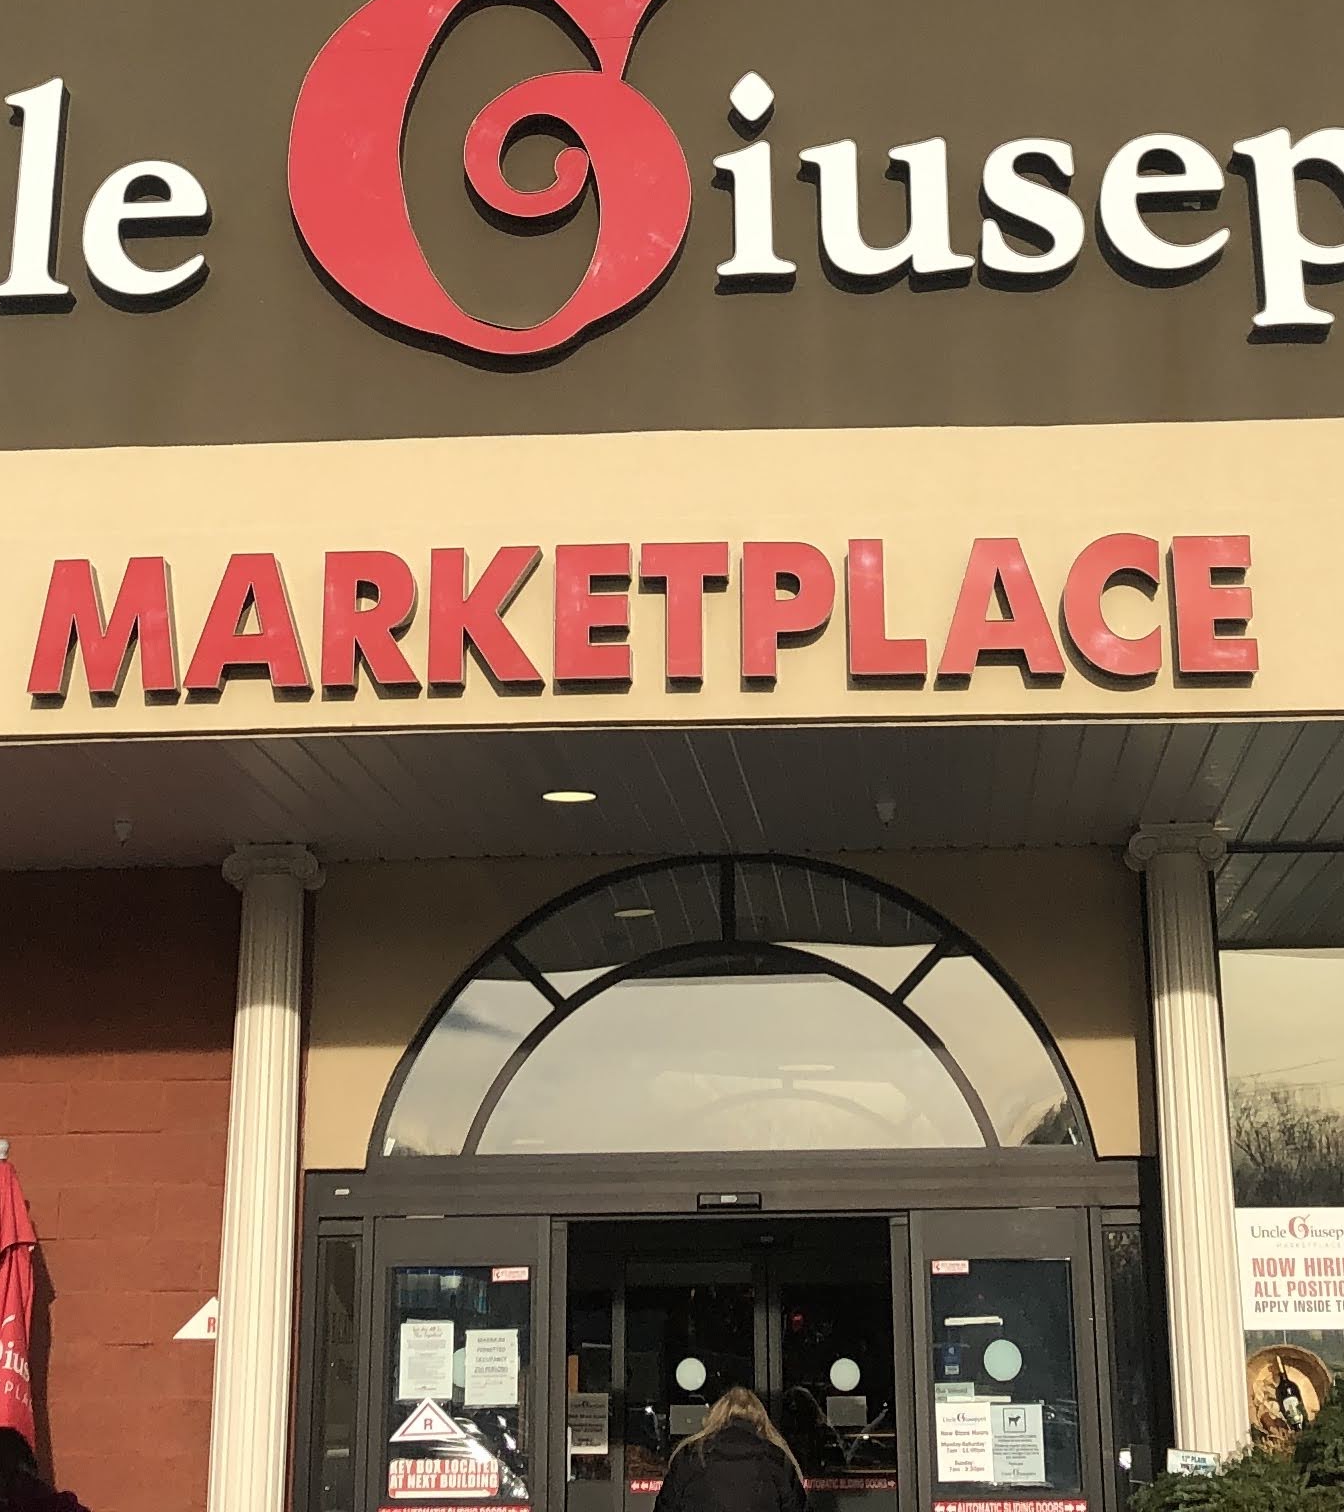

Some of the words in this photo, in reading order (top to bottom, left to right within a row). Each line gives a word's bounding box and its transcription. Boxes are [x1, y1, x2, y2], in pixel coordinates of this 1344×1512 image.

[27, 531, 1260, 696] MARKETPLACE
[1250, 1225, 1287, 1239] Uncle
[1252, 1257, 1296, 1278] NOW
[1254, 1280, 1281, 1298] ALL
[1254, 1300, 1289, 1313] APPLY
[1293, 1299, 1331, 1313] INSIDE
[207, 1316, 216, 1333] R
[423, 1418, 433, 1431] R
[390, 1459, 413, 1475] KEY
[417, 1459, 441, 1474] BOX
[444, 1458, 498, 1474] LOCATED
[389, 1475, 405, 1489] AT
[407, 1474, 437, 1489] NEXT
[440, 1473, 498, 1489] BUILDING
[958, 1501, 1003, 1512] AUTOMATIC
[1003, 1501, 1035, 1512] SLIDING
[1036, 1500, 1064, 1512] DOORS
